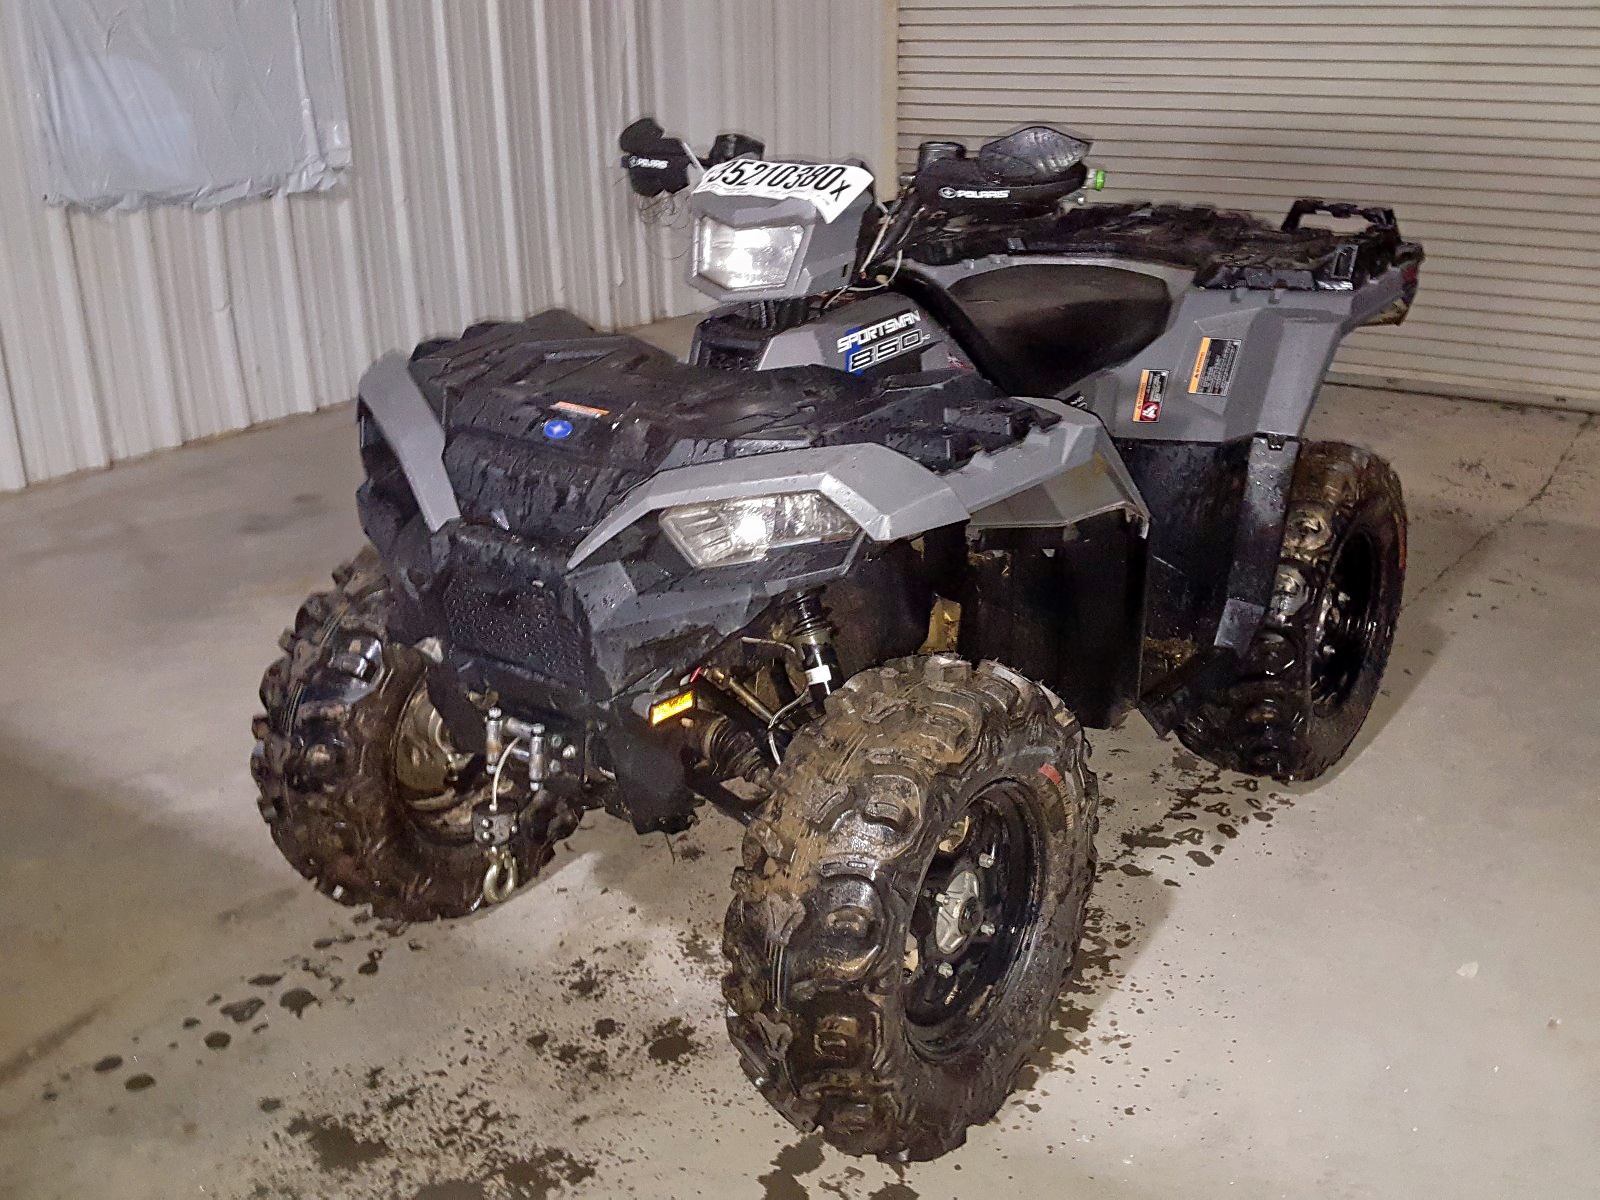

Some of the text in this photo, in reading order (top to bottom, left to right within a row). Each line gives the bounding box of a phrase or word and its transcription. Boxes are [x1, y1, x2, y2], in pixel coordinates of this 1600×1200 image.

[955, 189, 1010, 199] POLARIS
[837, 310, 921, 353] SPORTSMAN
[849, 329, 922, 372] 850
